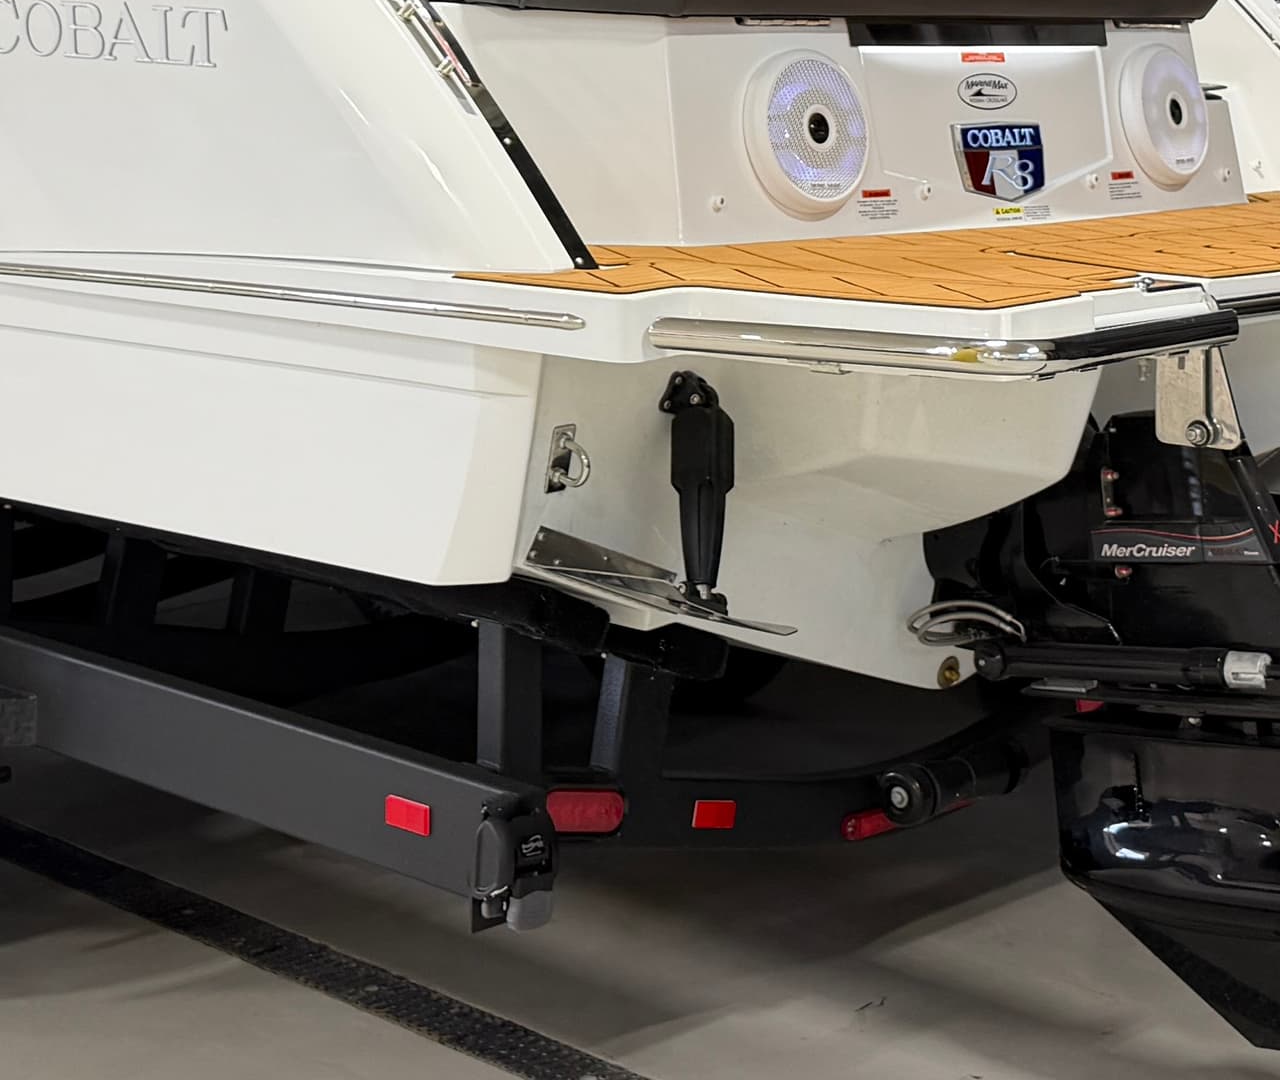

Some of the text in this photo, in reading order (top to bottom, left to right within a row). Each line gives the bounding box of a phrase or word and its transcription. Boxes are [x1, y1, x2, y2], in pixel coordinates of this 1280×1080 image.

[967, 128, 1035, 147] COBALT
[980, 154, 1035, 190] R8
[1100, 543, 1196, 558] MerCruiser
